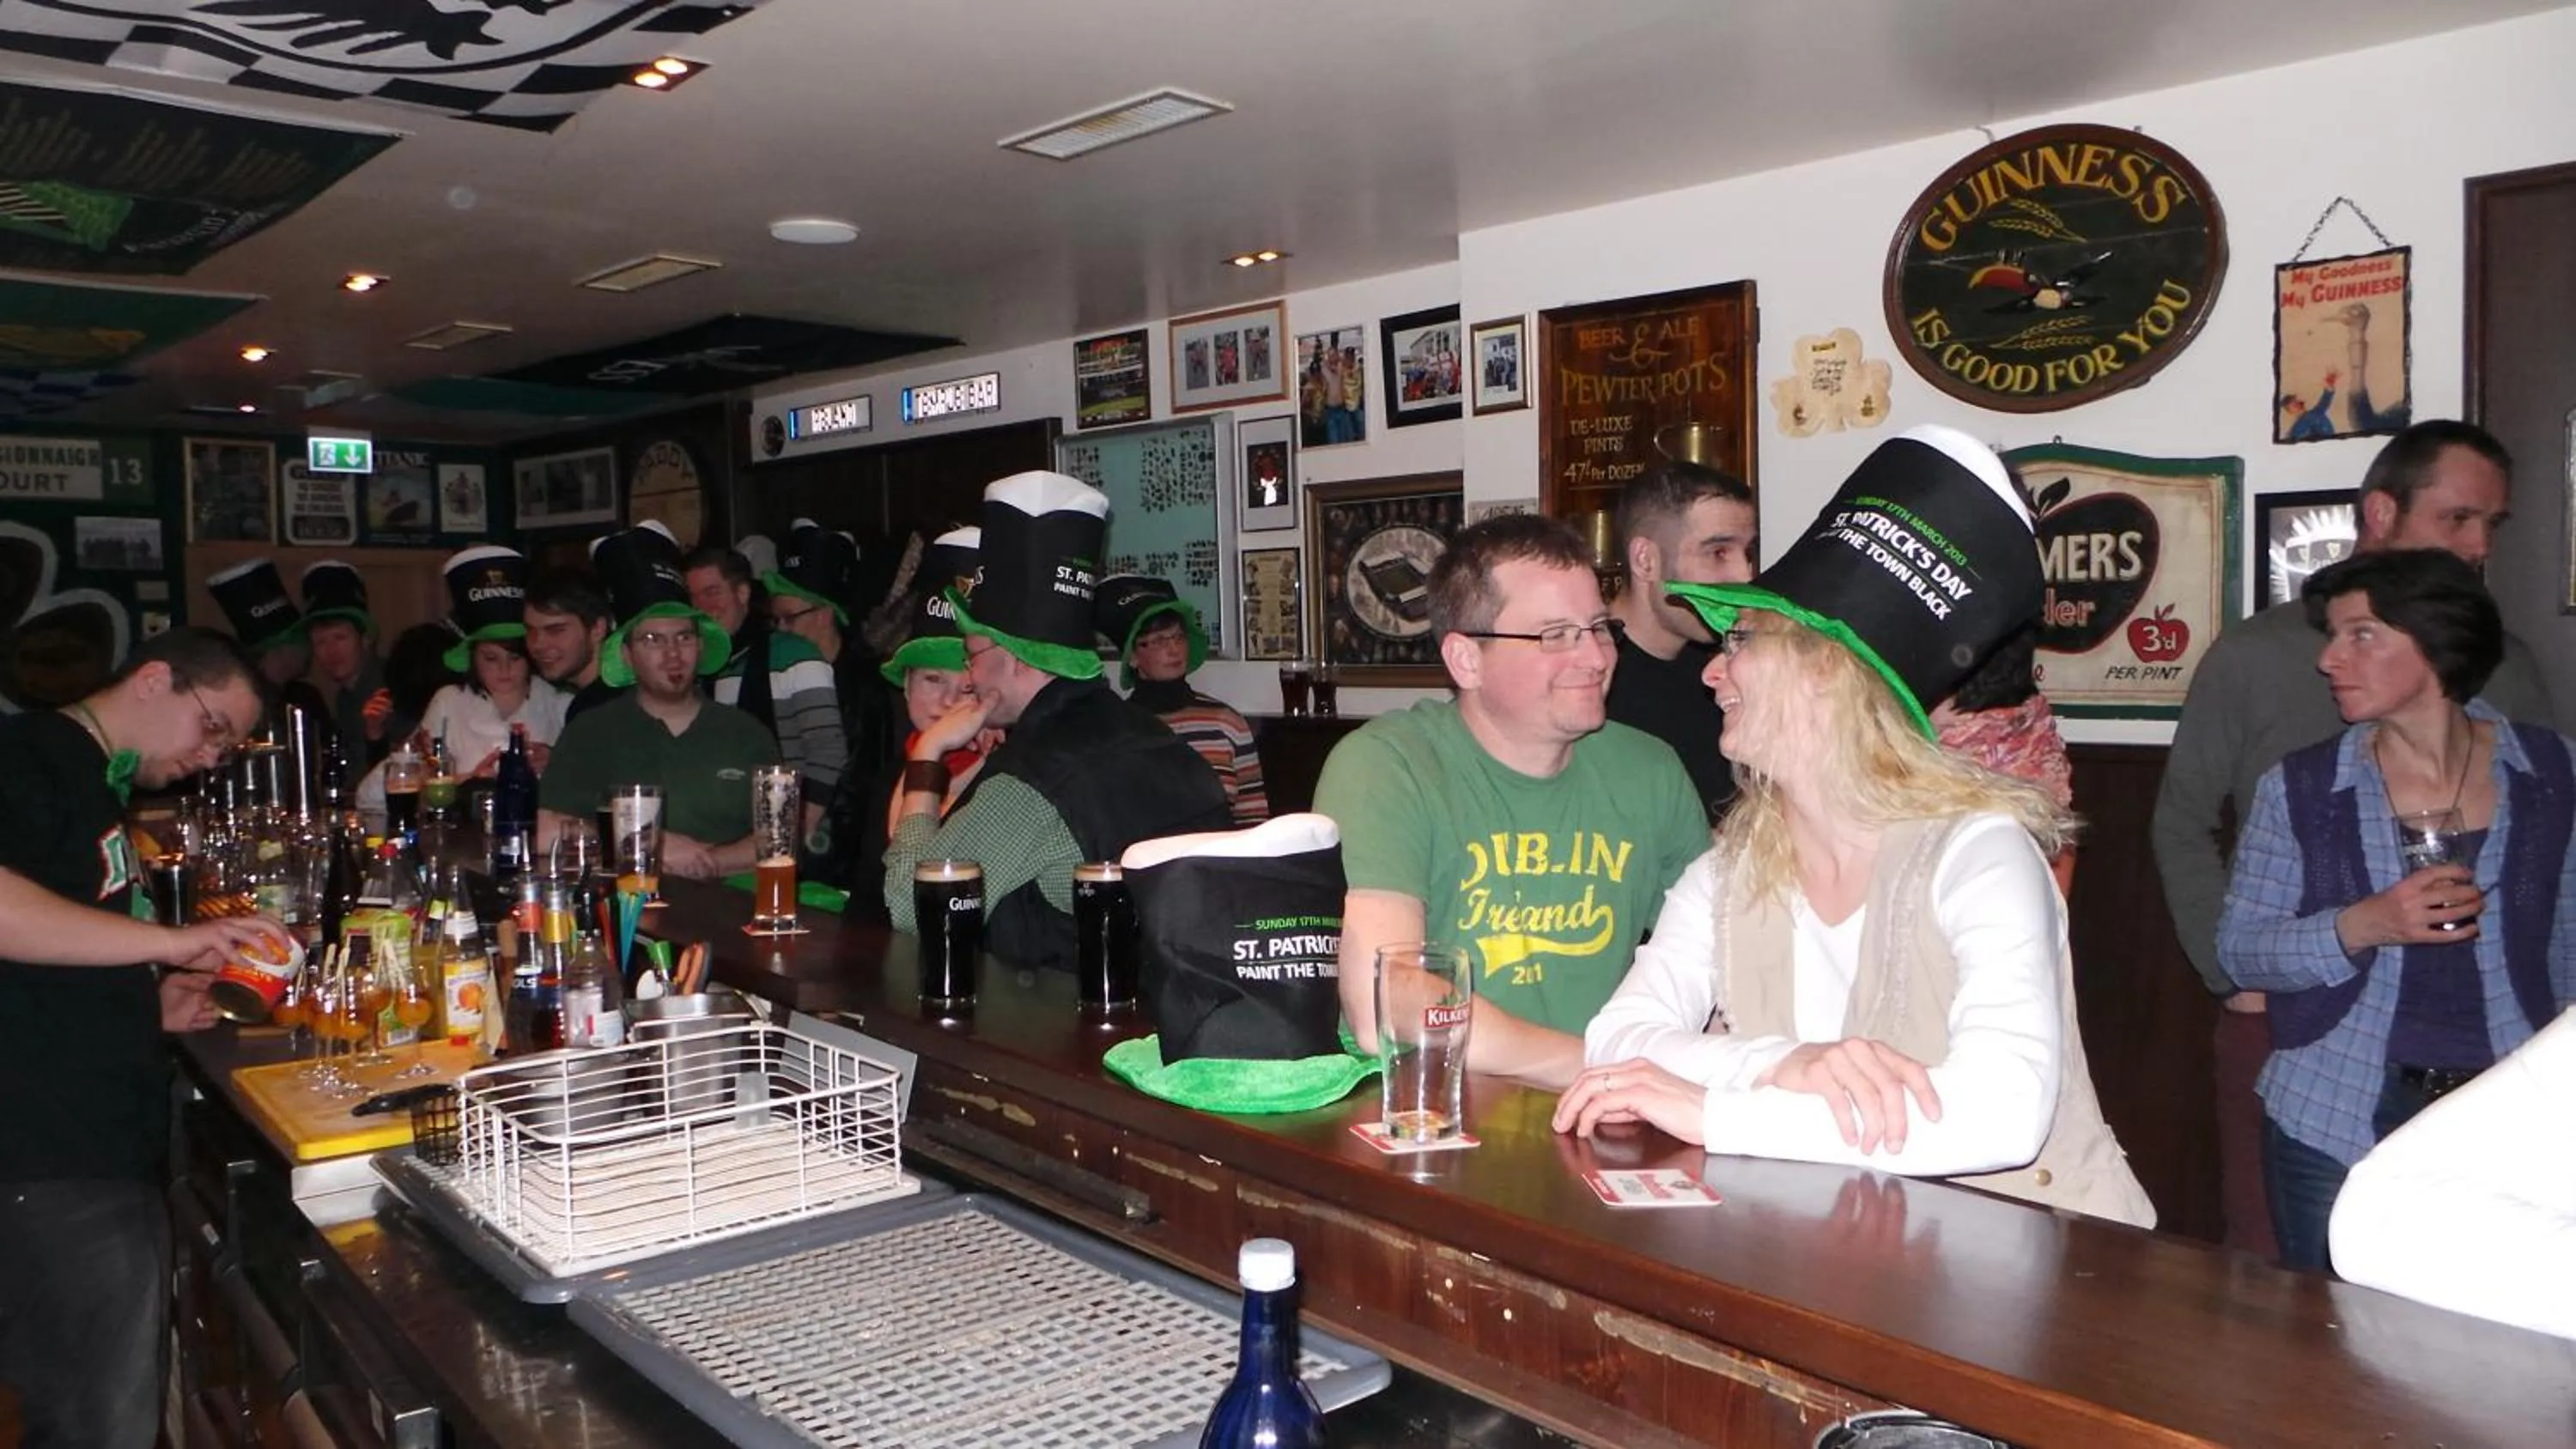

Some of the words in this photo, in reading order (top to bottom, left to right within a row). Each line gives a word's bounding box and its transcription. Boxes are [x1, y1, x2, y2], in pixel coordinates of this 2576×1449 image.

[1920, 142, 2187, 252] GUINNESS
[2292, 270, 2313, 285] My
[2319, 260, 2393, 280] Goodness
[2281, 292, 2305, 309] My
[2311, 276, 2403, 302] GUINNESS
[1577, 325, 1627, 350] BEER
[1660, 316, 1701, 339] ALE
[1911, 307, 1951, 349] IS
[1941, 343, 2039, 394] GOOD
[2044, 343, 2126, 394] FOR
[2117, 278, 2192, 356] YOU
[1559, 365, 1658, 408] PEWTER
[1662, 352, 1727, 397] POTS
[1570, 415, 1634, 436] DE-LUXE
[1583, 435, 1625, 456] PINTS
[0, 470, 70, 493] OURT
[109, 457, 143, 485] 13
[1886, 502, 1911, 521] 17TH
[1909, 515, 1947, 549] MARCH
[1943, 544, 1968, 567] 2013
[1851, 511, 1937, 570] PATRICK'S
[1930, 562, 1973, 601] DAY
[2035, 530, 2144, 583] MERS
[1838, 528, 1869, 550] THE
[1865, 542, 1913, 582] TOWN
[1907, 575, 1952, 621] BLACK
[927, 596, 957, 620] GUIN
[2105, 666, 2139, 680] PER
[2141, 665, 2184, 680] PINT
[1255, 917, 1297, 931] SUNDAY
[1300, 916, 1321, 927] 17TH
[1233, 938, 1263, 961] ST.
[1269, 934, 1340, 958] PATRIC
[512, 976, 538, 989] OLS
[1236, 963, 1282, 980] PAINT
[1285, 962, 1315, 979] THE
